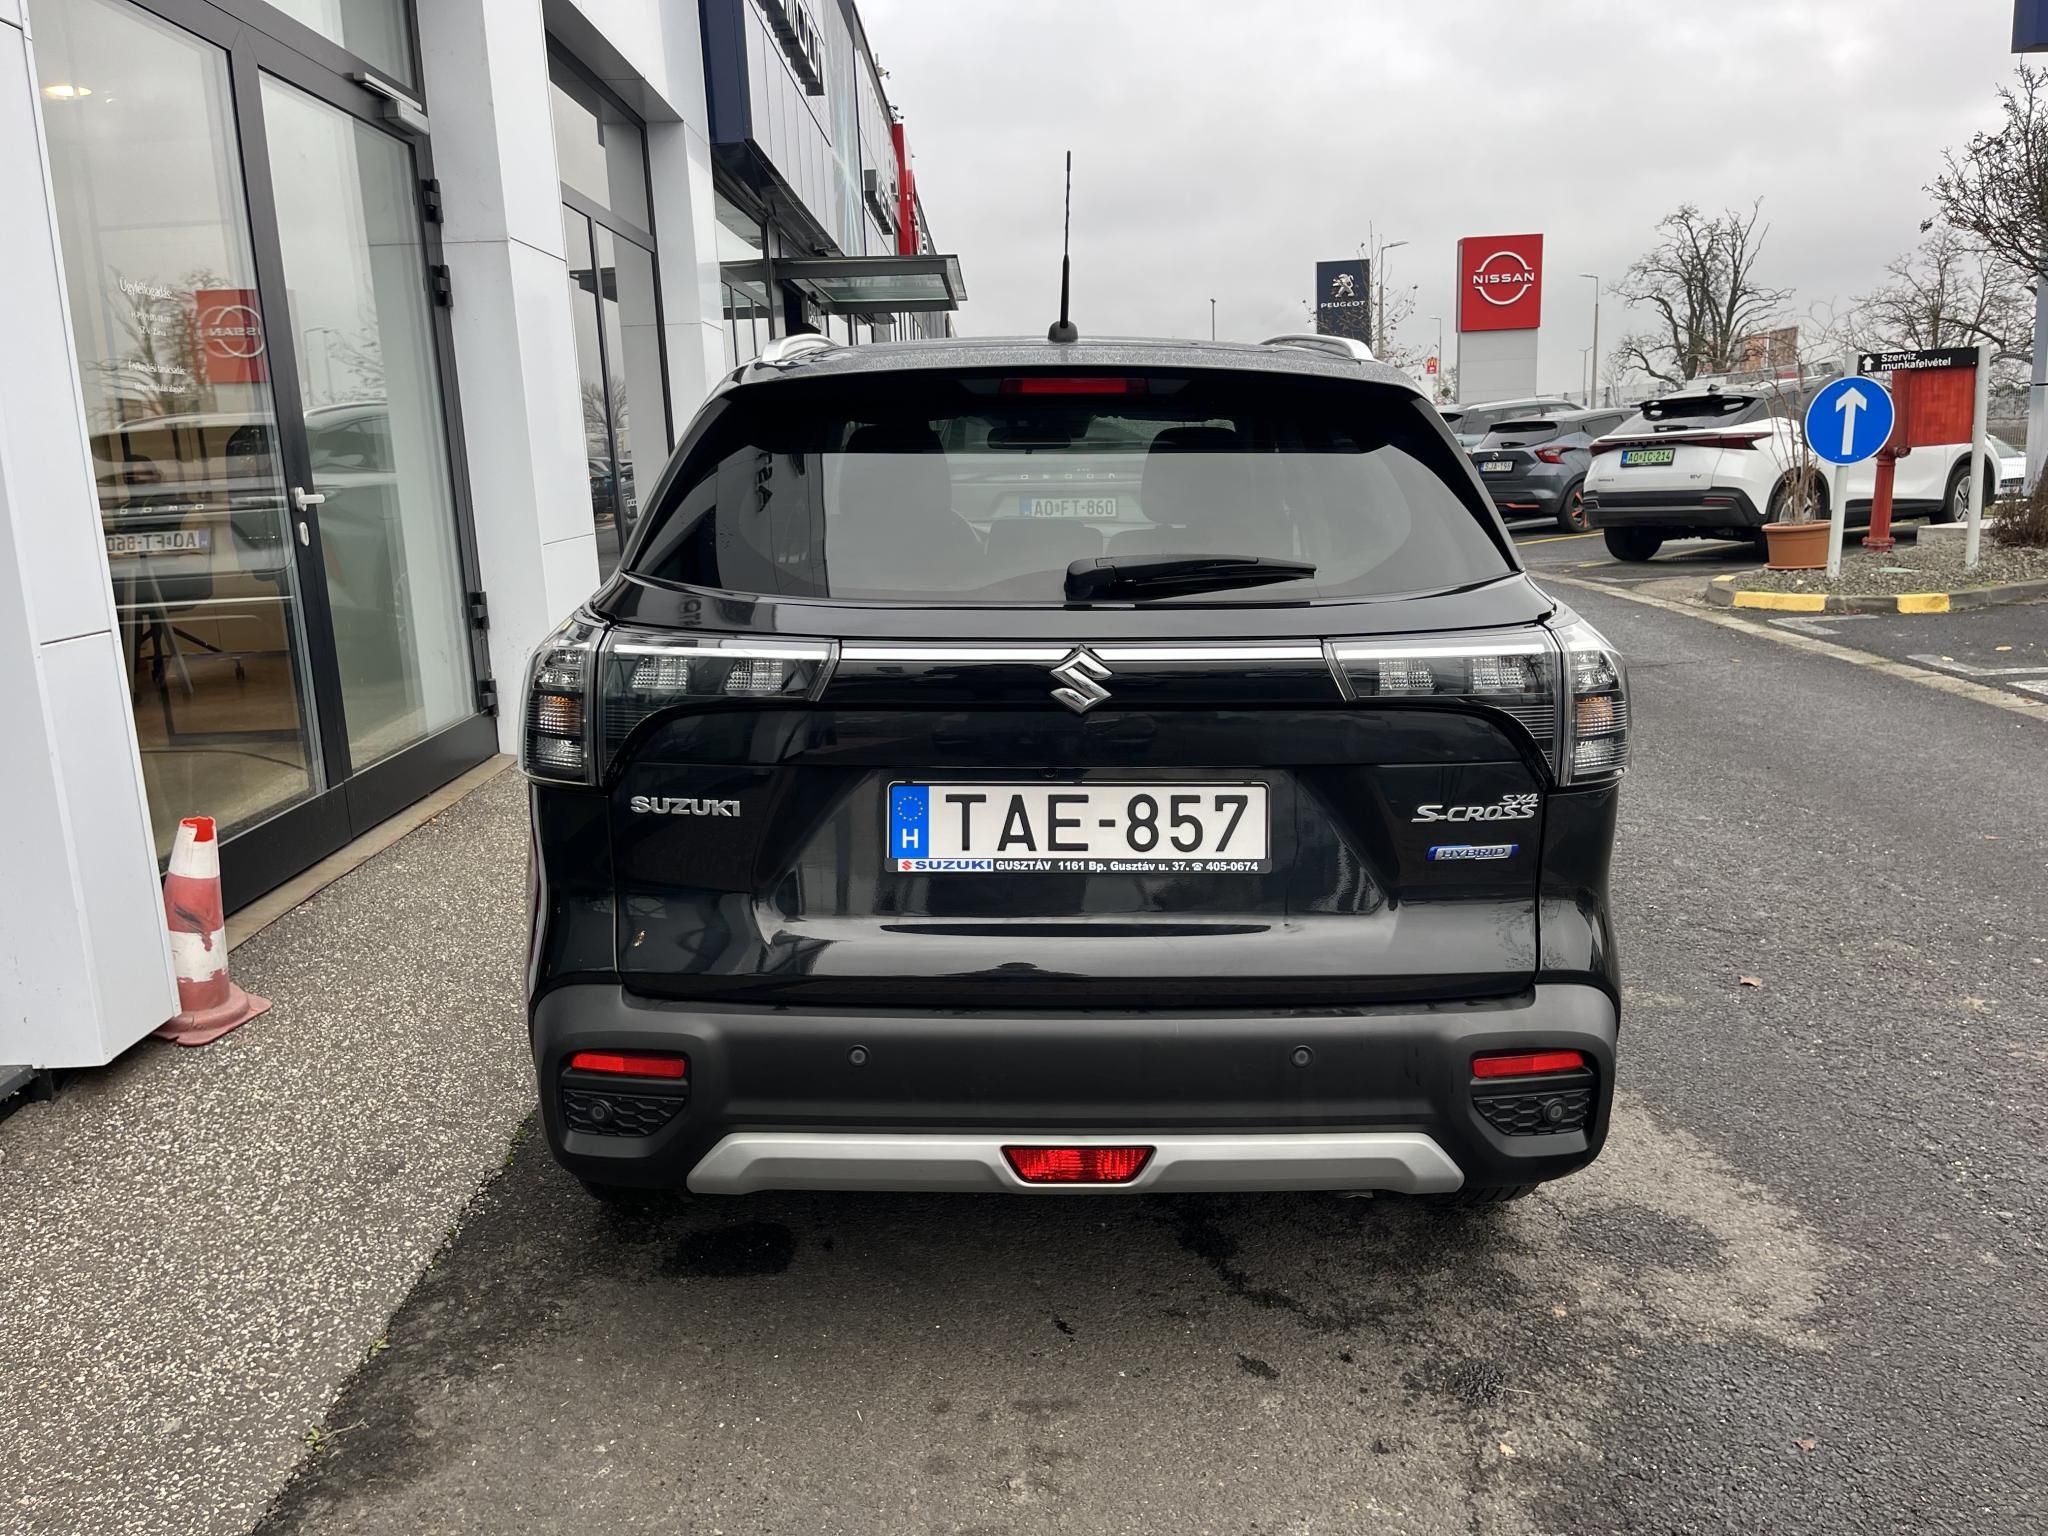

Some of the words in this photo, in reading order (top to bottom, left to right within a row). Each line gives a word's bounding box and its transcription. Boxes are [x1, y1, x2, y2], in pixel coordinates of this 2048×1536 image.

[1473, 272, 1535, 285] NISSAN
[1881, 353, 1916, 363] Szerviz
[1881, 357, 1951, 371] munkafelvétel
[1498, 793, 1539, 806] SX4
[630, 796, 740, 817] SUZUKI
[1411, 804, 1538, 822] S-CROSS
[945, 793, 1249, 852] TAE-857
[902, 828, 919, 849] H
[1440, 847, 1506, 859] HYBRID
[915, 860, 992, 870] SUZUKI
[996, 859, 1051, 870] GUSZTÁV
[1058, 861, 1085, 870] 1161
[1088, 861, 1107, 872] Bp.
[1110, 861, 1155, 871] Gusztáv
[1158, 863, 1169, 871] u.
[1172, 862, 1190, 871] 37.
[1205, 862, 1258, 871] 405-0674
